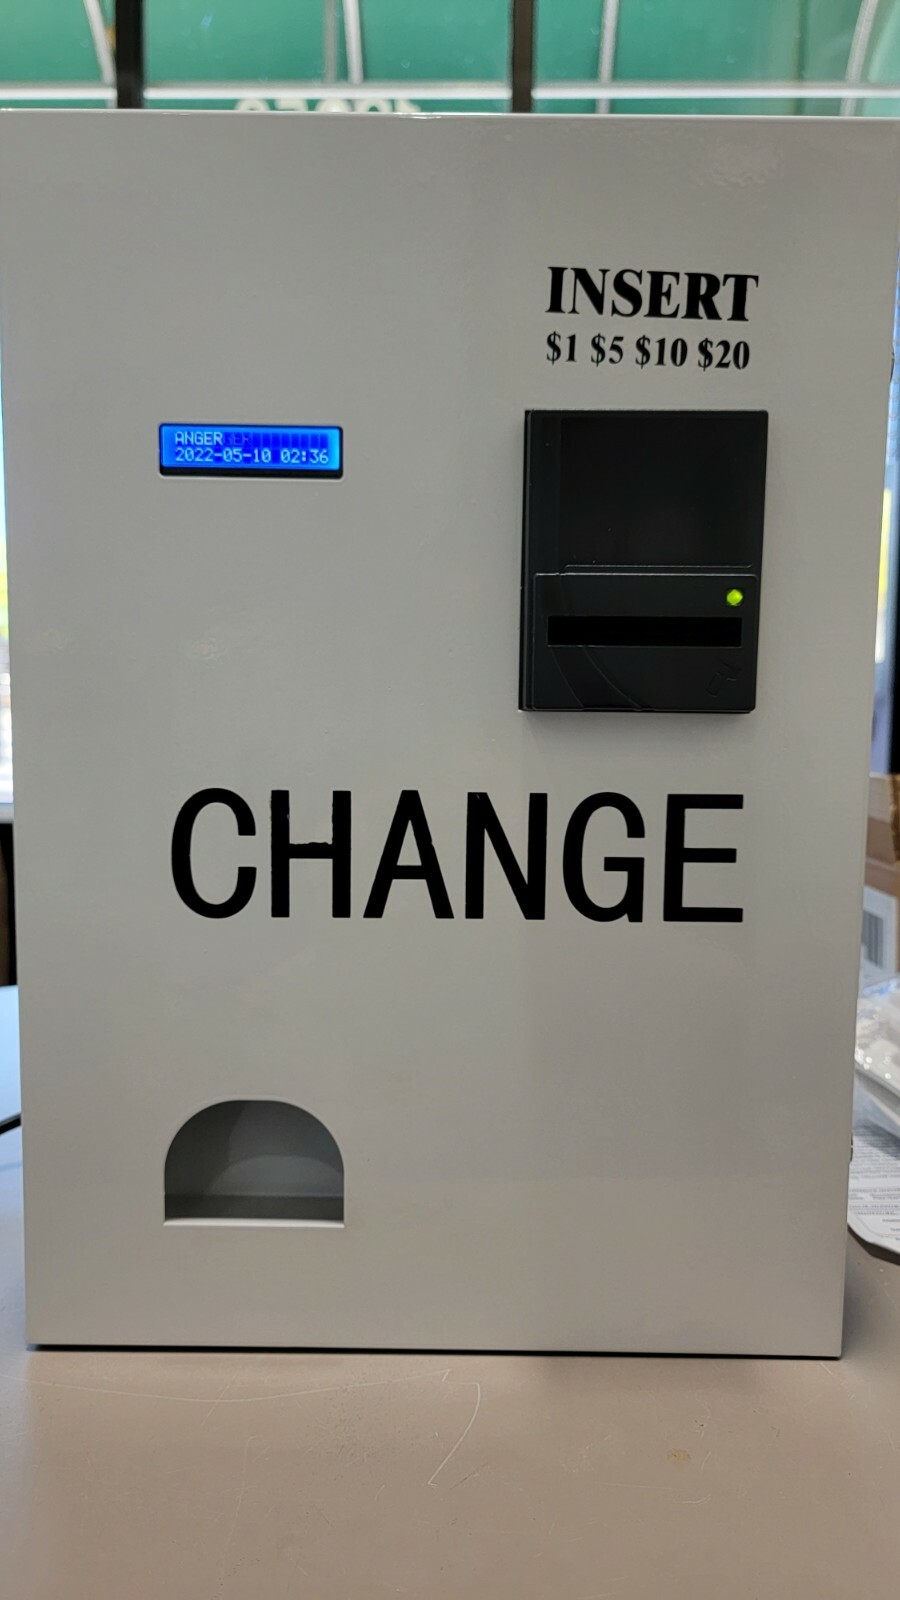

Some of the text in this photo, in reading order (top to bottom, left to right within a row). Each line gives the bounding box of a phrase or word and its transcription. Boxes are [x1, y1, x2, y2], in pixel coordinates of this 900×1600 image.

[545, 266, 759, 321] INSERT
[546, 331, 750, 372] $1 $5 $10 $20
[175, 448, 329, 464] 2022-05-10 02:36
[170, 787, 745, 924] CHANGE
